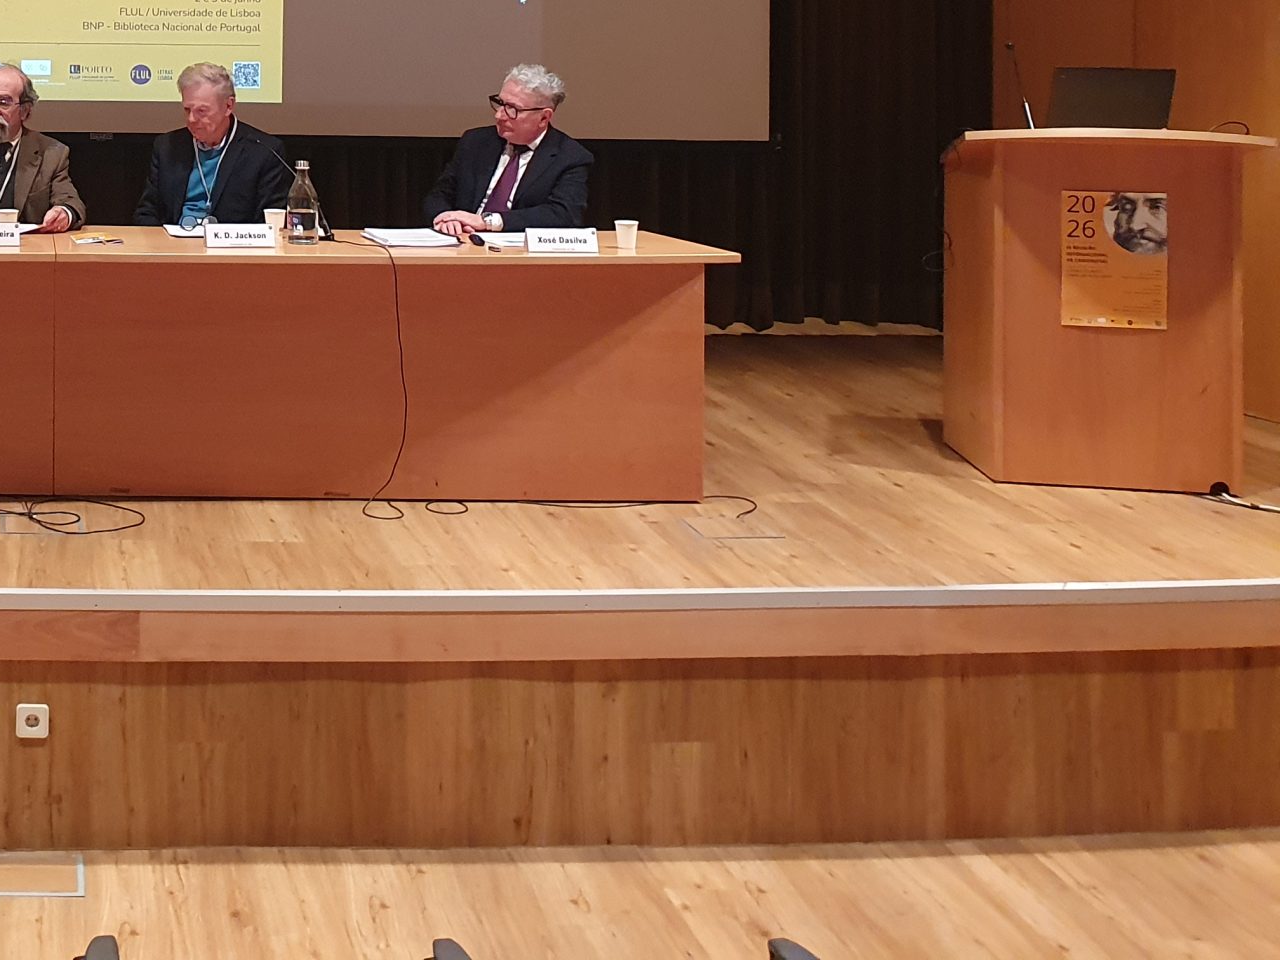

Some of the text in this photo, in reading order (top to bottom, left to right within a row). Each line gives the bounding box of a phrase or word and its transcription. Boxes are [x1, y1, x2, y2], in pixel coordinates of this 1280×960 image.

[119, 7, 261, 19] FLUL / Universidade de Lisboa
[82, 21, 105, 31] BNP
[113, 21, 160, 32] Biblioteca
[162, 22, 203, 32] Nacional
[205, 22, 217, 33] de
[219, 23, 261, 34] Portugal
[131, 69, 151, 79] FLUL
[1067, 195, 1095, 214] 20
[235, 231, 267, 239] Jackson
[1067, 219, 1096, 239] 26
[537, 235, 588, 244] Xosé Dasilva
